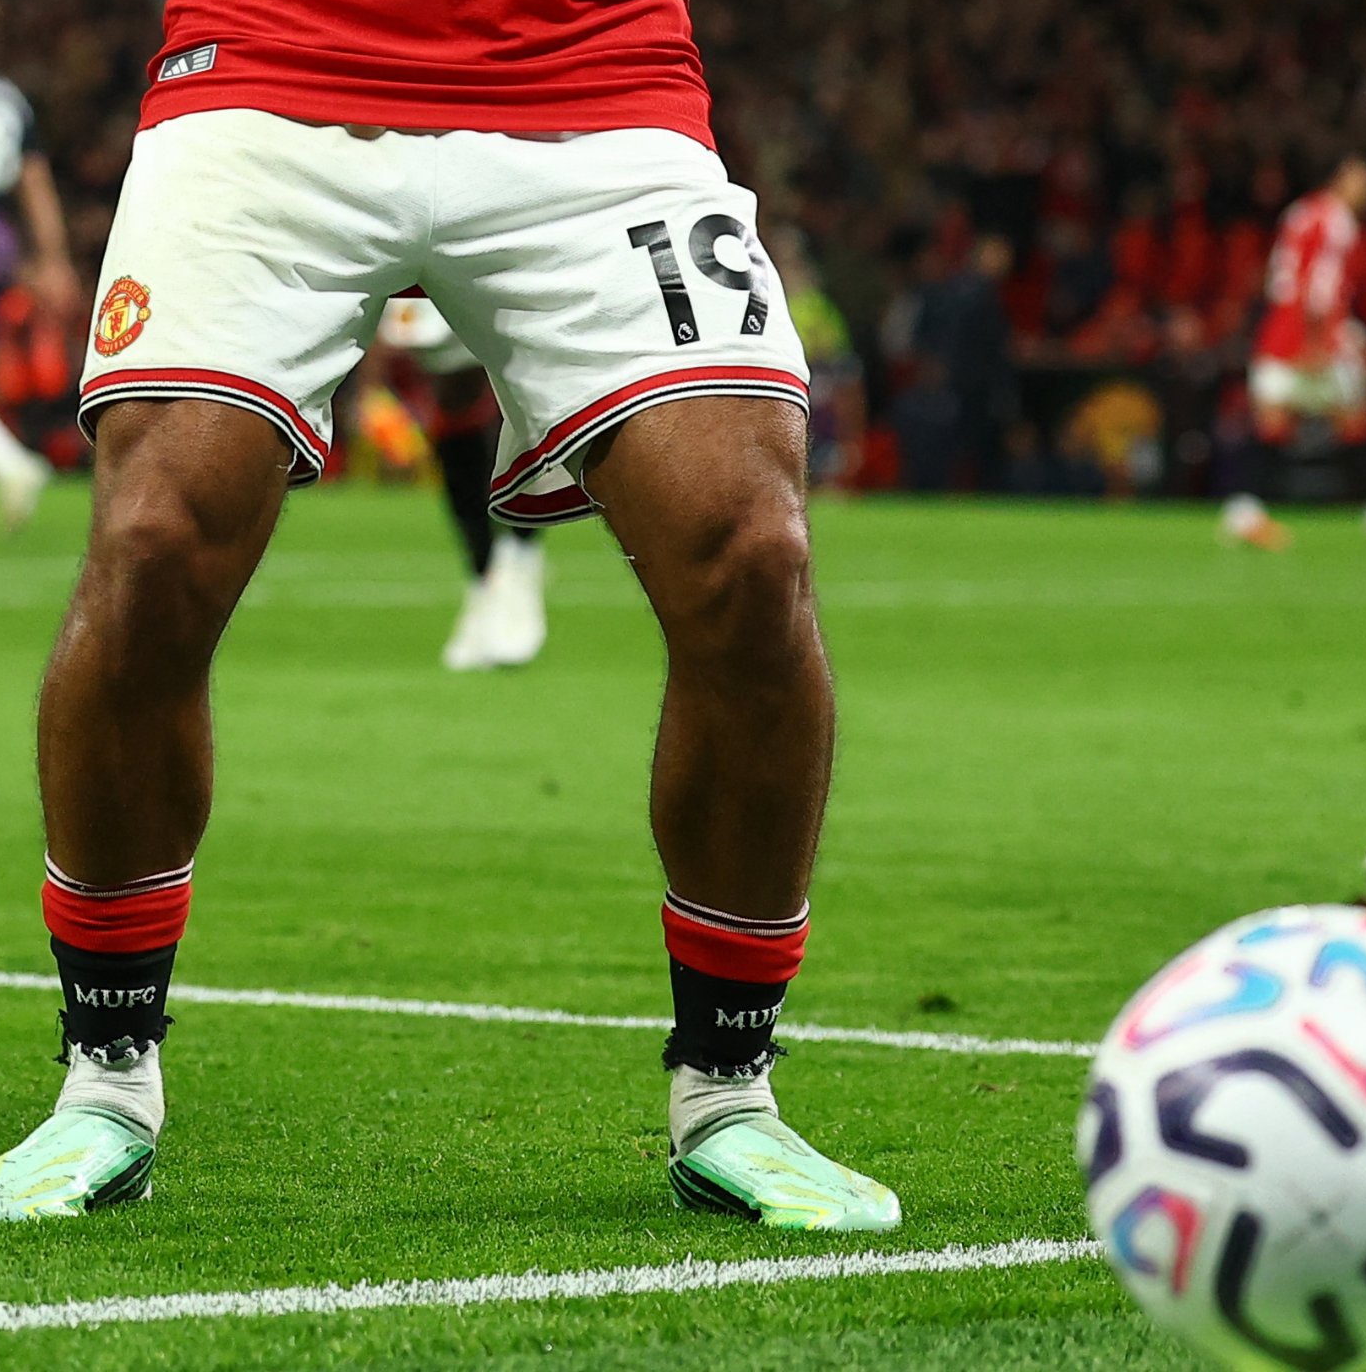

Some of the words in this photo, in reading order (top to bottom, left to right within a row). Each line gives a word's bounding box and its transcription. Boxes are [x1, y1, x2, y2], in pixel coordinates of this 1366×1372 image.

[627, 213, 769, 347] 19
[74, 982, 157, 1009] MUFC
[715, 995, 786, 1031] MUF
